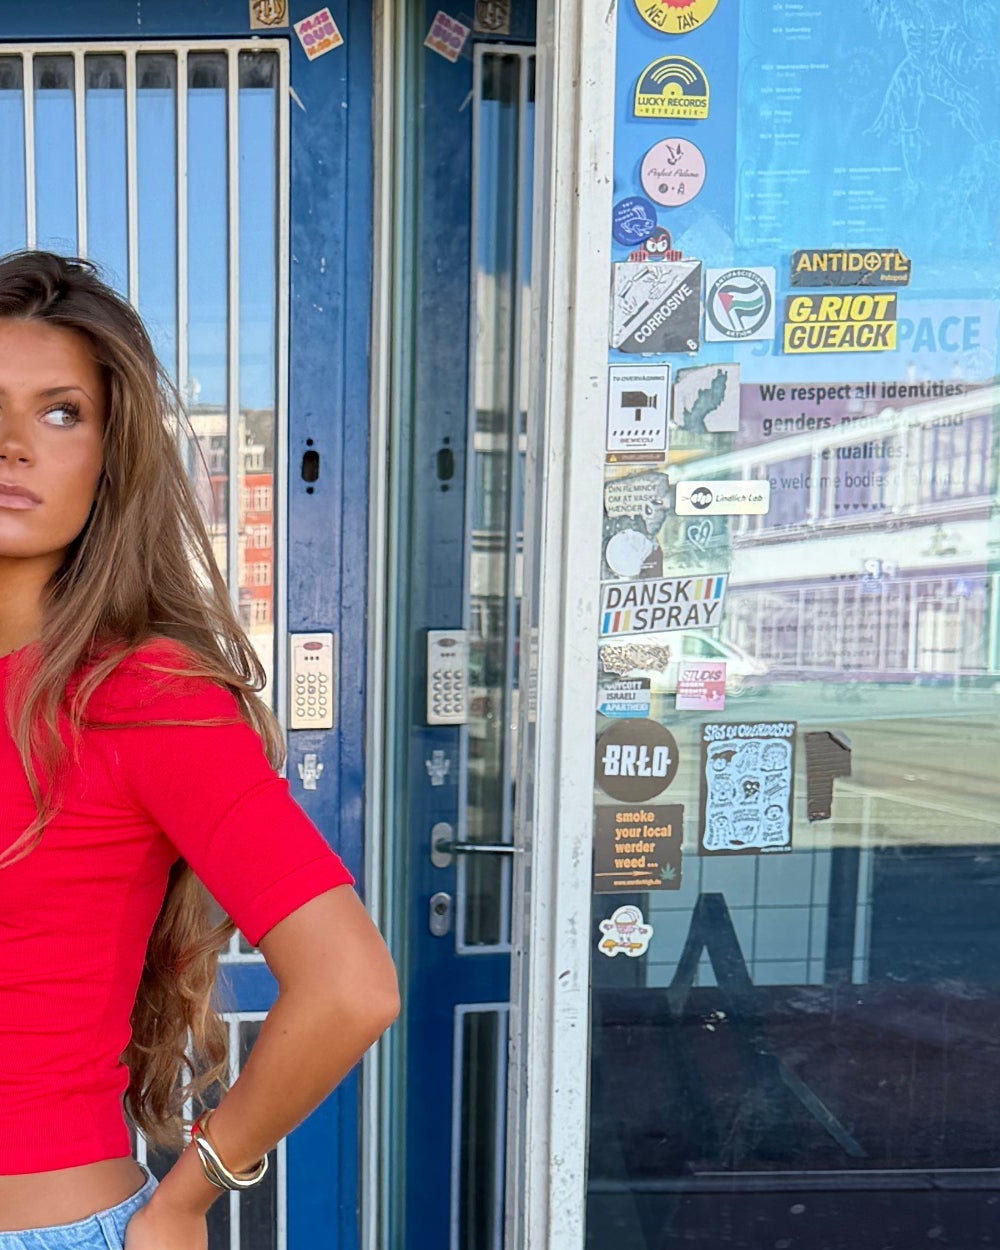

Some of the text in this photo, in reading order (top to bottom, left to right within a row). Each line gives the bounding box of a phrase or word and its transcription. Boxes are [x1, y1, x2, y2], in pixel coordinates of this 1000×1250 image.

[645, 5, 699, 30] NEJ TAK
[638, 97, 707, 107] LUCKY RECORDS
[796, 252, 909, 272] ANTIDOTE
[634, 283, 693, 344] CORROSIVE
[788, 295, 896, 322] G.RIOT
[788, 324, 893, 349] GUEACK
[897, 316, 981, 353] PACE
[759, 384, 785, 402] We
[791, 384, 851, 404] respect
[855, 382, 875, 399] all
[813, 440, 909, 460] eualities.
[781, 474, 841, 490] welcme
[606, 580, 692, 609] DANSK
[633, 602, 719, 630] SPRAY
[606, 692, 636, 701] ISRAELI
[605, 703, 649, 711] APARTHEID
[615, 810, 655, 823] smoke
[615, 824, 672, 840] your local
[615, 841, 655, 853] werder
[615, 856, 646, 868] weed
